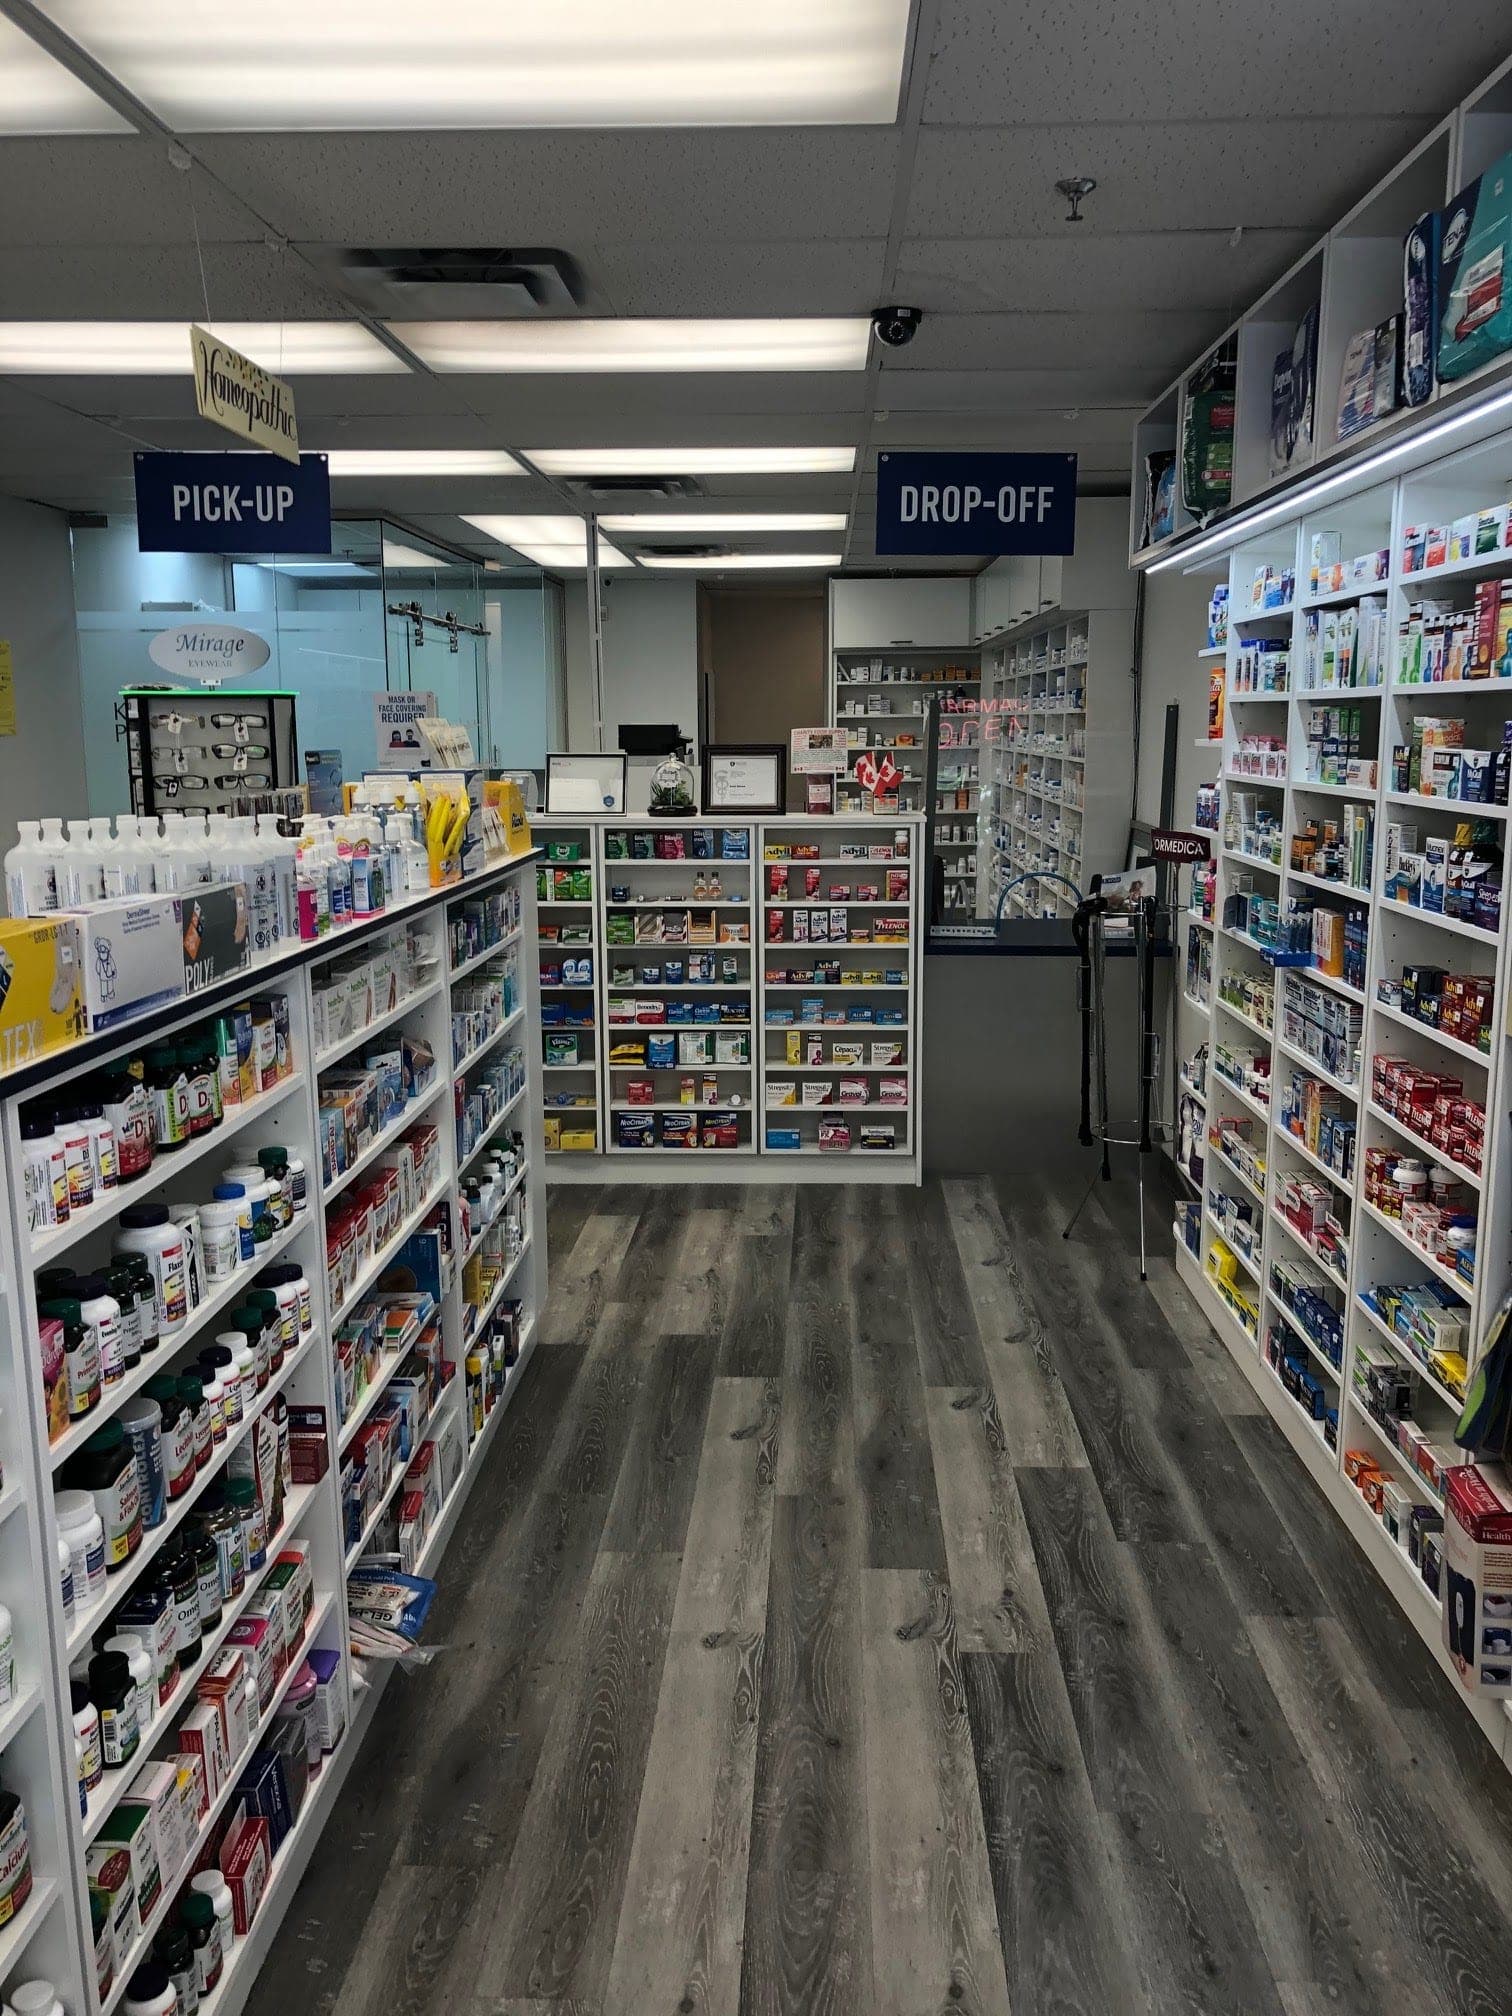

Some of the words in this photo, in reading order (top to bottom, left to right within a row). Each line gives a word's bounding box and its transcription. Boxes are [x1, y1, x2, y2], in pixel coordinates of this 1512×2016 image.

[199, 340, 298, 441] Homeopathic
[173, 485, 294, 522] PICK-UP
[901, 485, 1055, 523] DROP-OFF
[175, 634, 245, 658] Mirage
[188, 659, 233, 669] EYEWEAR
[388, 695, 406, 704] MASK
[406, 695, 416, 704] OR
[378, 704, 394, 713] FACE
[395, 704, 427, 713] COVERING
[766, 846, 790, 856] Advil
[841, 846, 866, 855] Advil
[185, 957, 210, 994] POLY
